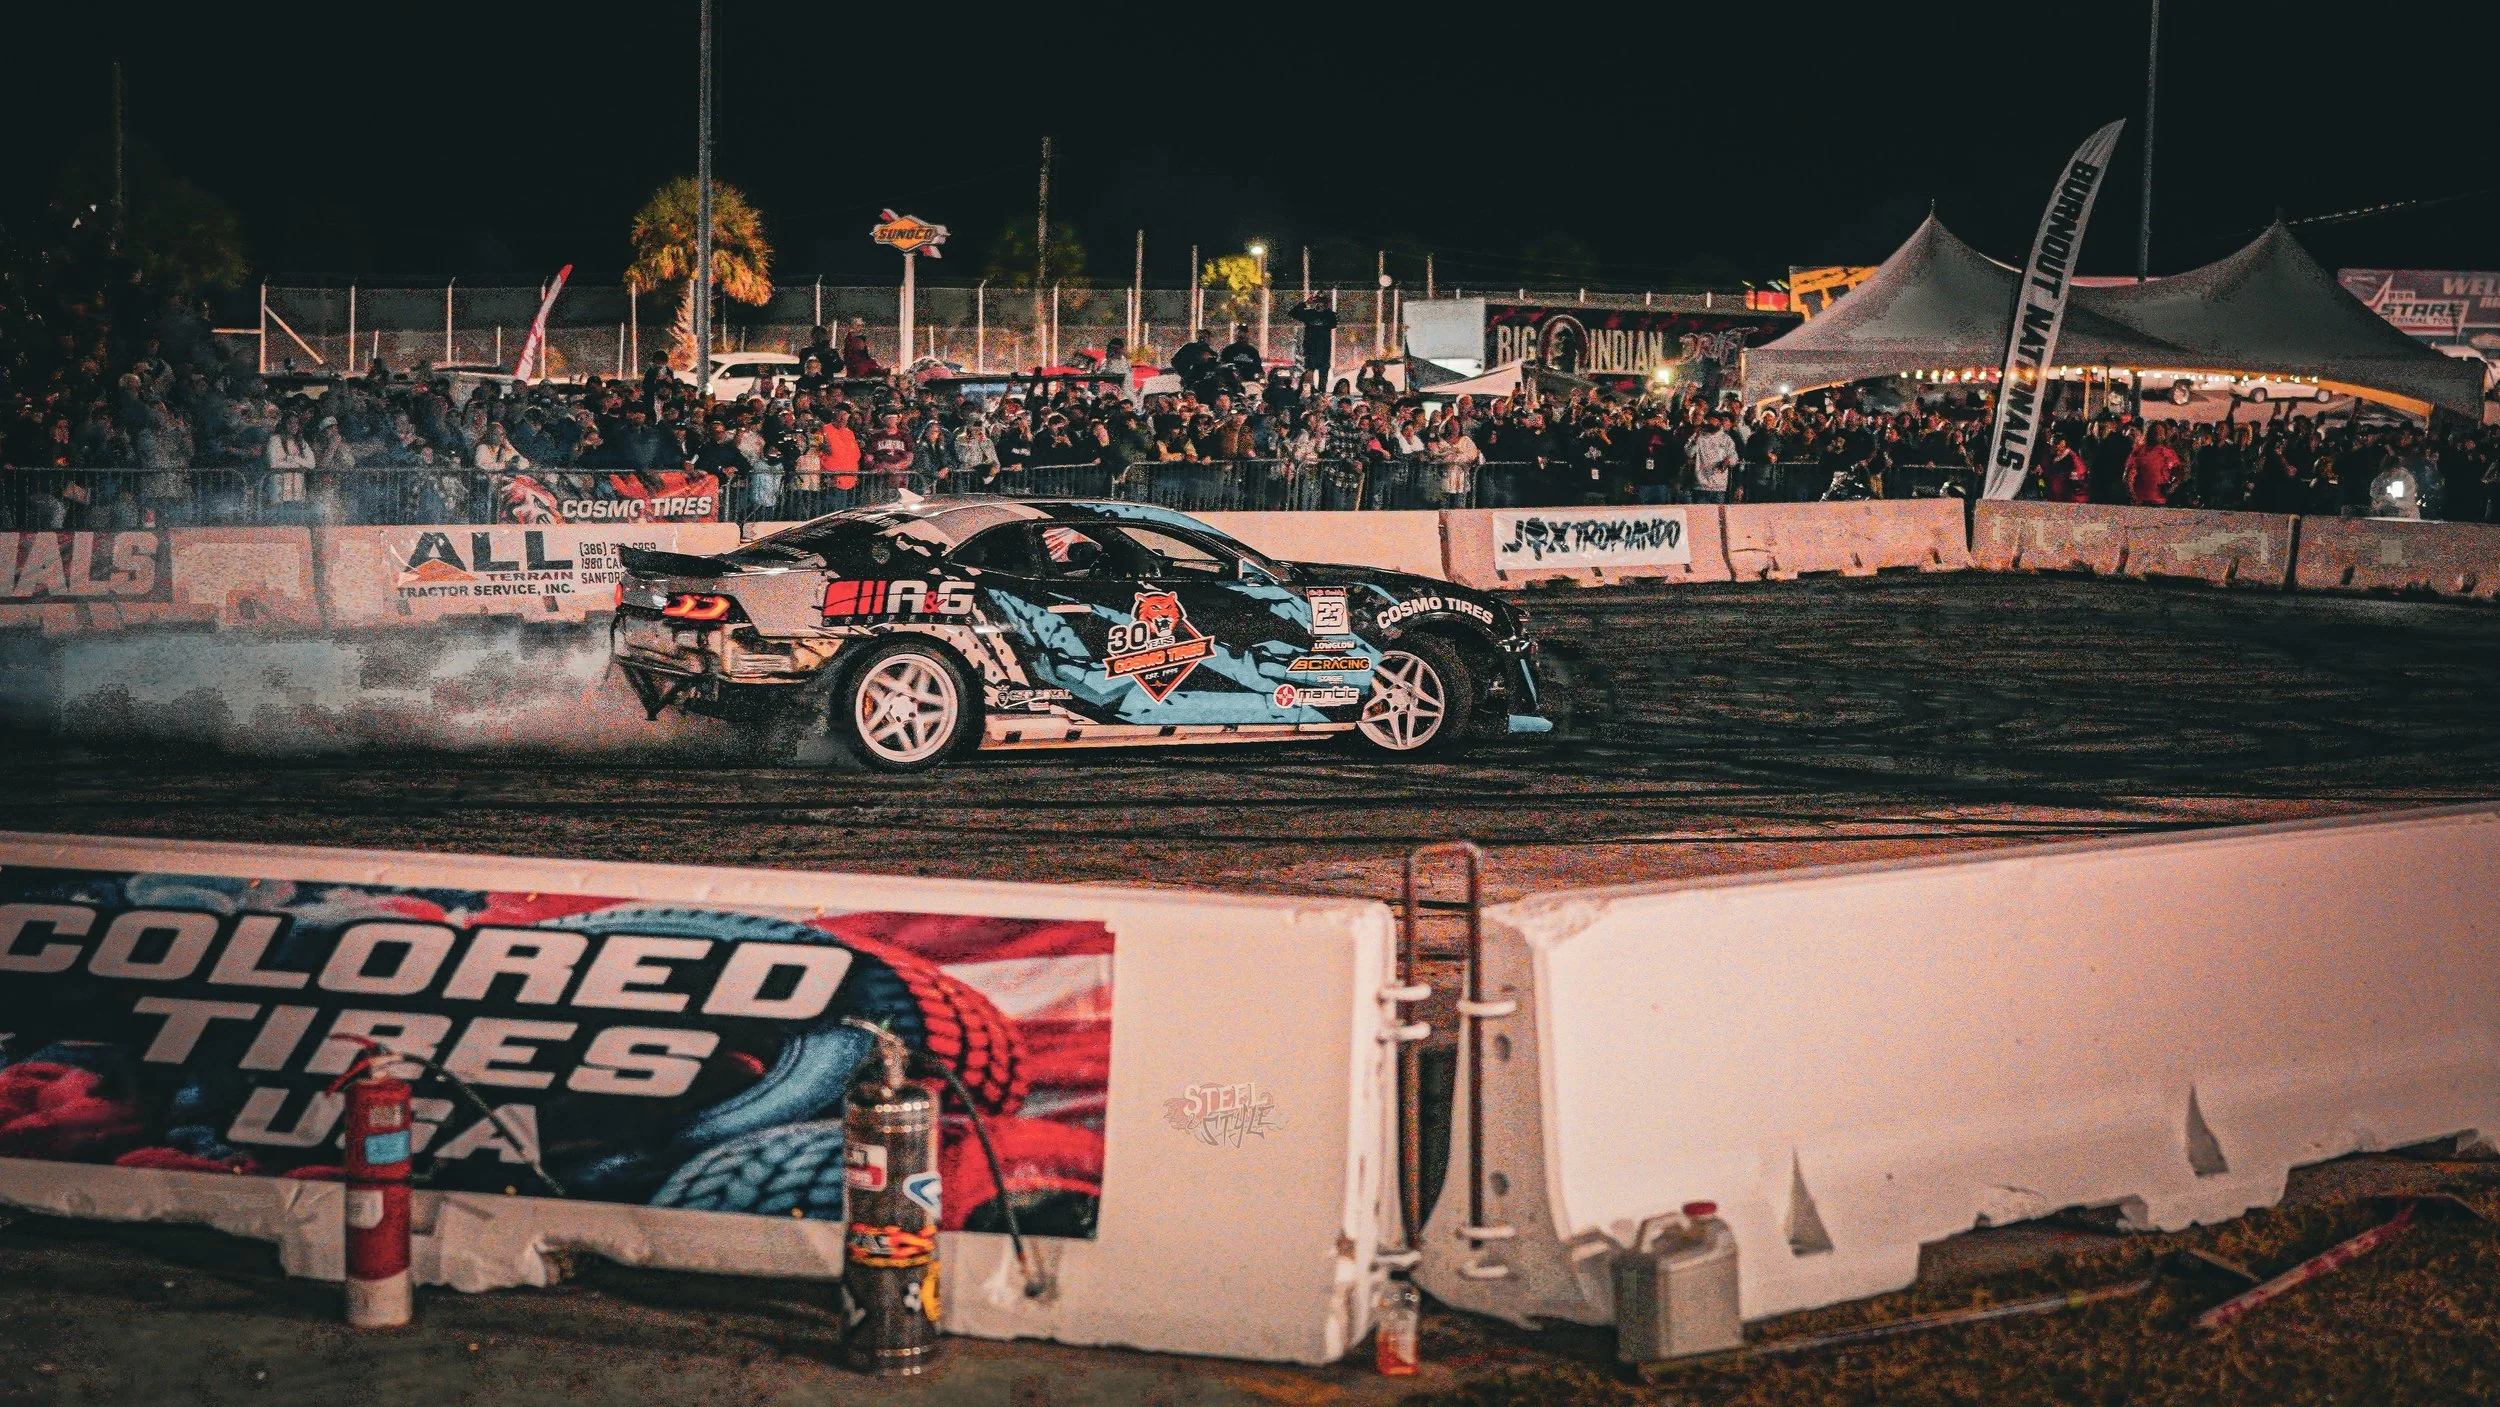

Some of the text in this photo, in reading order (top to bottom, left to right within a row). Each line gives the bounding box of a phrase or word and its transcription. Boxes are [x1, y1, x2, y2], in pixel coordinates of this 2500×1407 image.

[2031, 160, 2099, 299] BURNOUT
[1497, 325, 1537, 367] BIG
[1590, 328, 1664, 373] INDIAN
[562, 496, 712, 519] COSMO TIRES
[404, 531, 573, 571] ALL
[581, 558, 602, 569] 1980
[398, 583, 575, 598] TRACTOR SERVICE, INC.
[486, 571, 573, 581] TERRAIN
[1315, 602, 1345, 627] 23
[1376, 596, 1494, 629] COSMO TIRES
[1107, 621, 1150, 654] 30
[1114, 650, 1165, 673] COSMO
[0, 903, 853, 1020] COLORED
[133, 996, 720, 1097] TIRES
